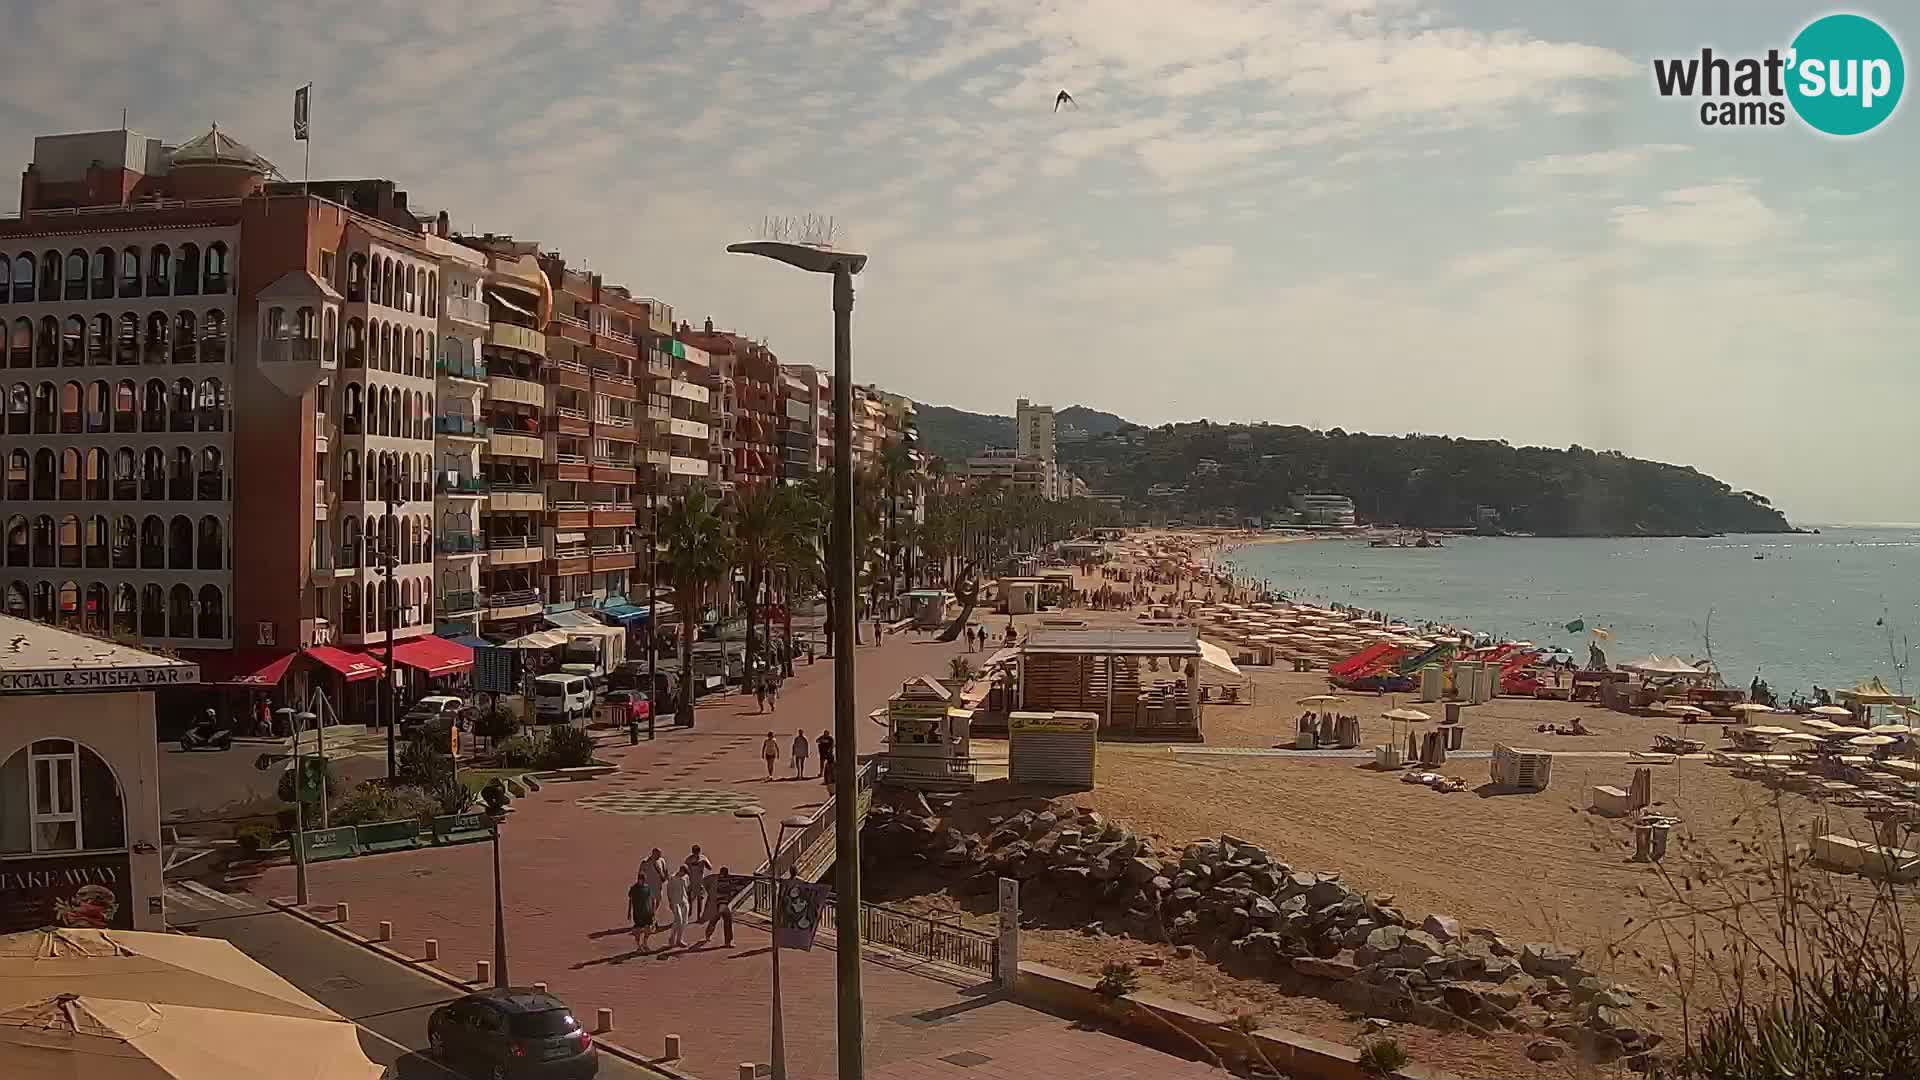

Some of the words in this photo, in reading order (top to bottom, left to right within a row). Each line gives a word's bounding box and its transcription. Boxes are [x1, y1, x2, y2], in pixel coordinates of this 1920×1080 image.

[63, 671, 75, 686] &
[80, 670, 140, 685] SHISHA
[145, 668, 179, 682] BAR
